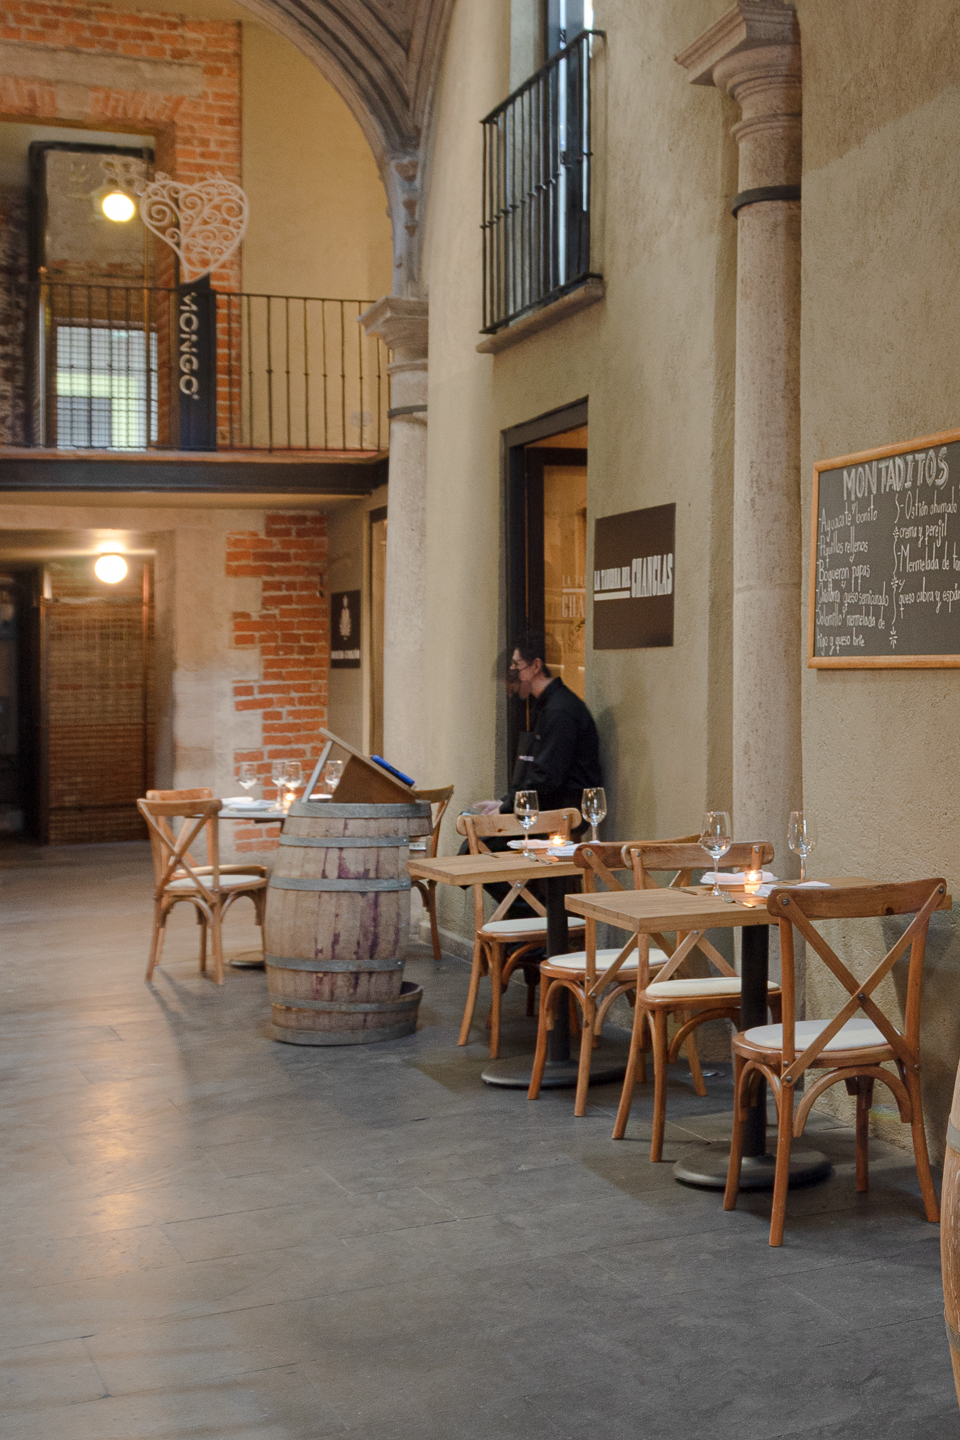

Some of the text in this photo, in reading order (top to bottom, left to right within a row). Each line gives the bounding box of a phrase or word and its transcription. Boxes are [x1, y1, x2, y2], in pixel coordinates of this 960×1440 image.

[843, 447, 949, 501] MONTADITOS
[632, 553, 673, 598] CHANCLAS
[942, 541, 949, 570] de
